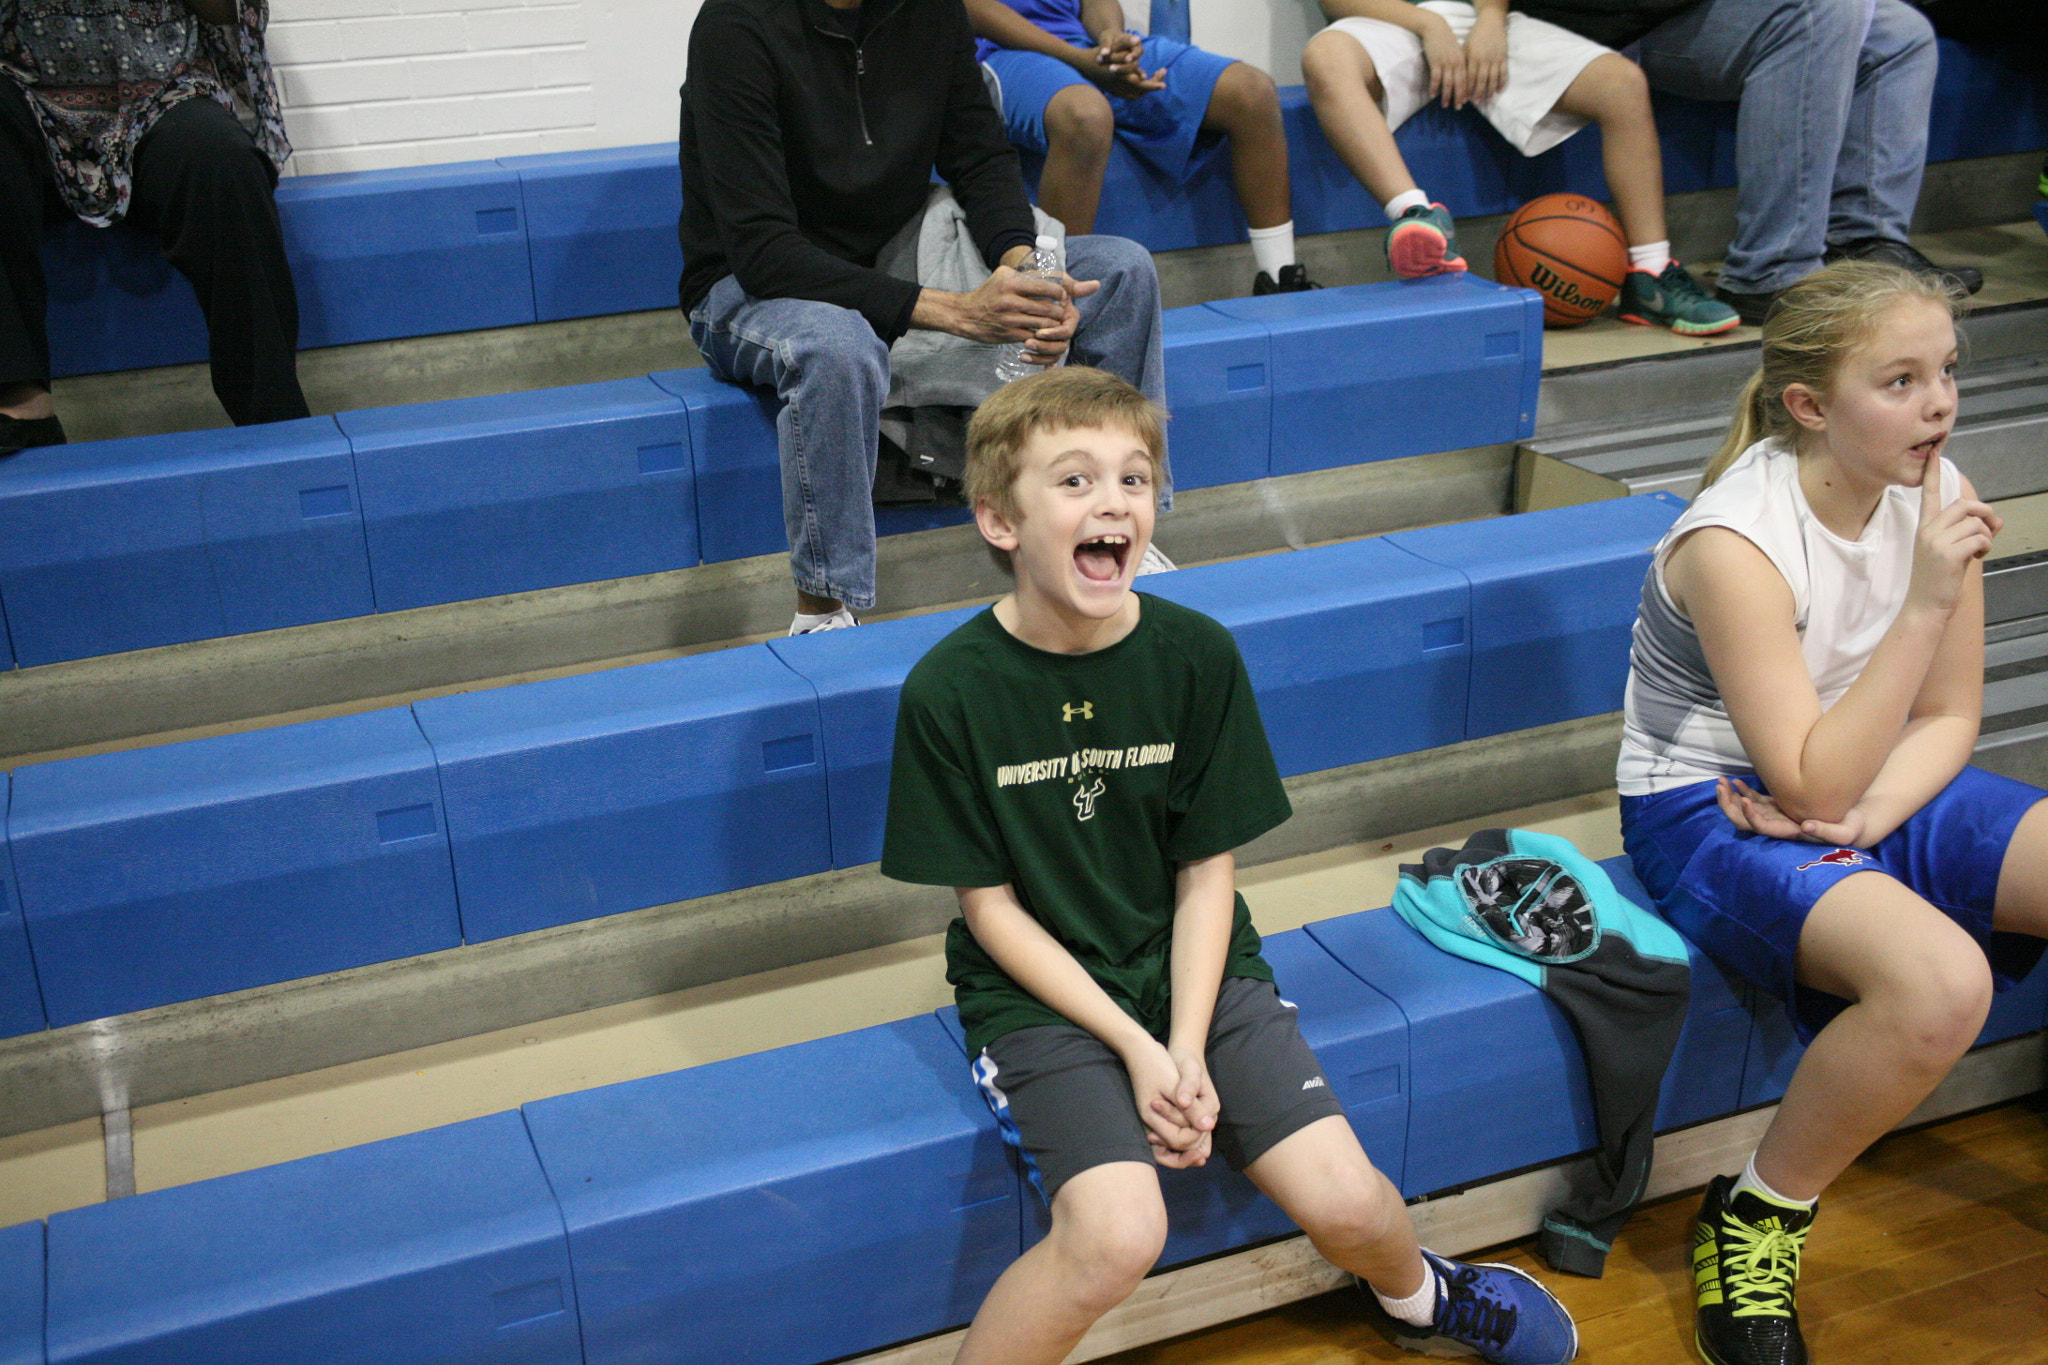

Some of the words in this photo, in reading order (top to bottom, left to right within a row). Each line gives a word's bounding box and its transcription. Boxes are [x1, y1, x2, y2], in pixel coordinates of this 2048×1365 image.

[1530, 262, 1605, 311] Wilson
[997, 756, 1068, 788] UNIVERSITY
[1081, 747, 1124, 769] SOUTH
[1124, 742, 1175, 768] FLORIDA
[1302, 1077, 1325, 1090] AVIA
